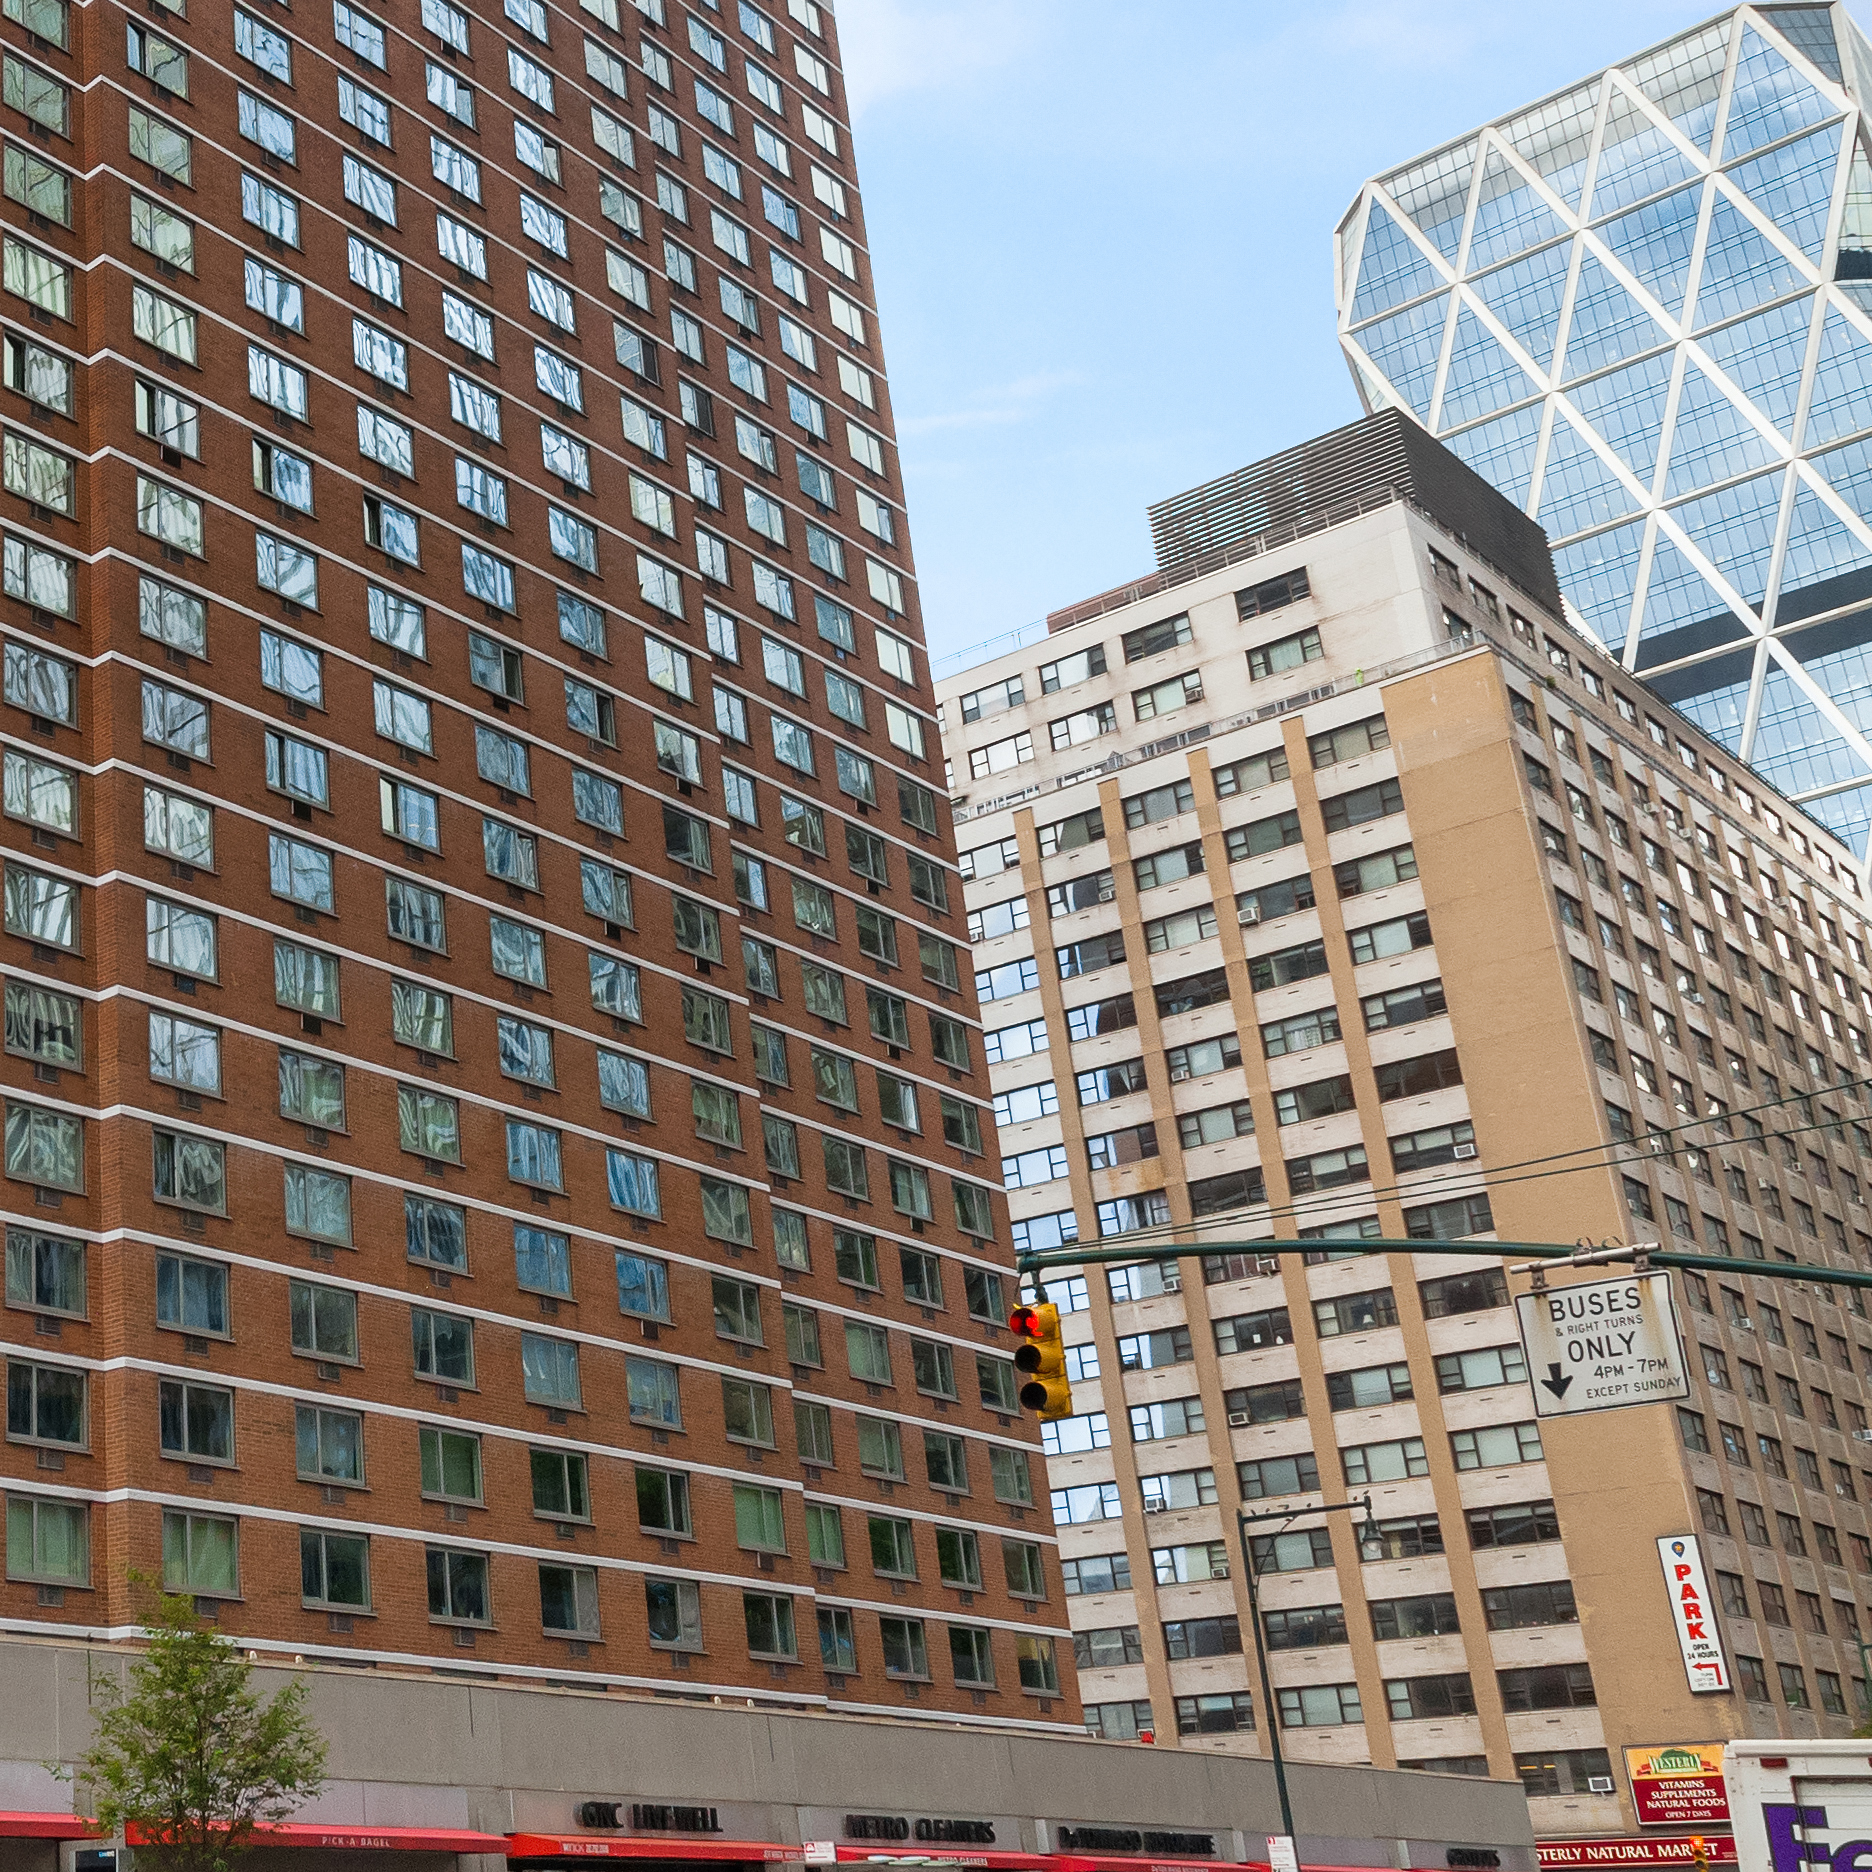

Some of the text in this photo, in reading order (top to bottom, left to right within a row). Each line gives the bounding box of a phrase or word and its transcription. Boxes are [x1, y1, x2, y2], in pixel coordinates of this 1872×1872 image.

[1548, 1286, 1641, 1322] BUSES
[1555, 1314, 1644, 1337] & RIGHT TURNS
[1568, 1331, 1636, 1363] ONLY
[1593, 1365, 1624, 1379] 4PM
[1637, 1358, 1669, 1373] 7PM
[1586, 1376, 1681, 1399] EXCEPT SUNDAY
[1674, 1564, 1708, 1640] PARK
[1692, 1643, 1710, 1651] OPEN
[1697, 1650, 1719, 1660] HOURS
[1651, 1789, 1717, 1799] SUPPLEMENTS
[1658, 1780, 1705, 1790] VITAMINS
[1646, 1797, 1726, 1809] NATURAL FOODS
[1665, 1811, 1685, 1819] OPEN
[1692, 1810, 1712, 1818] DAYS
[845, 1814, 910, 1840] METRO
[322, 1836, 344, 1845] PICK
[360, 1837, 390, 1848] BAGEL
[1535, 1847, 1581, 1862] STERLY
[1587, 1845, 1653, 1860] NATURAL
[1657, 1843, 1718, 1858] MARET
